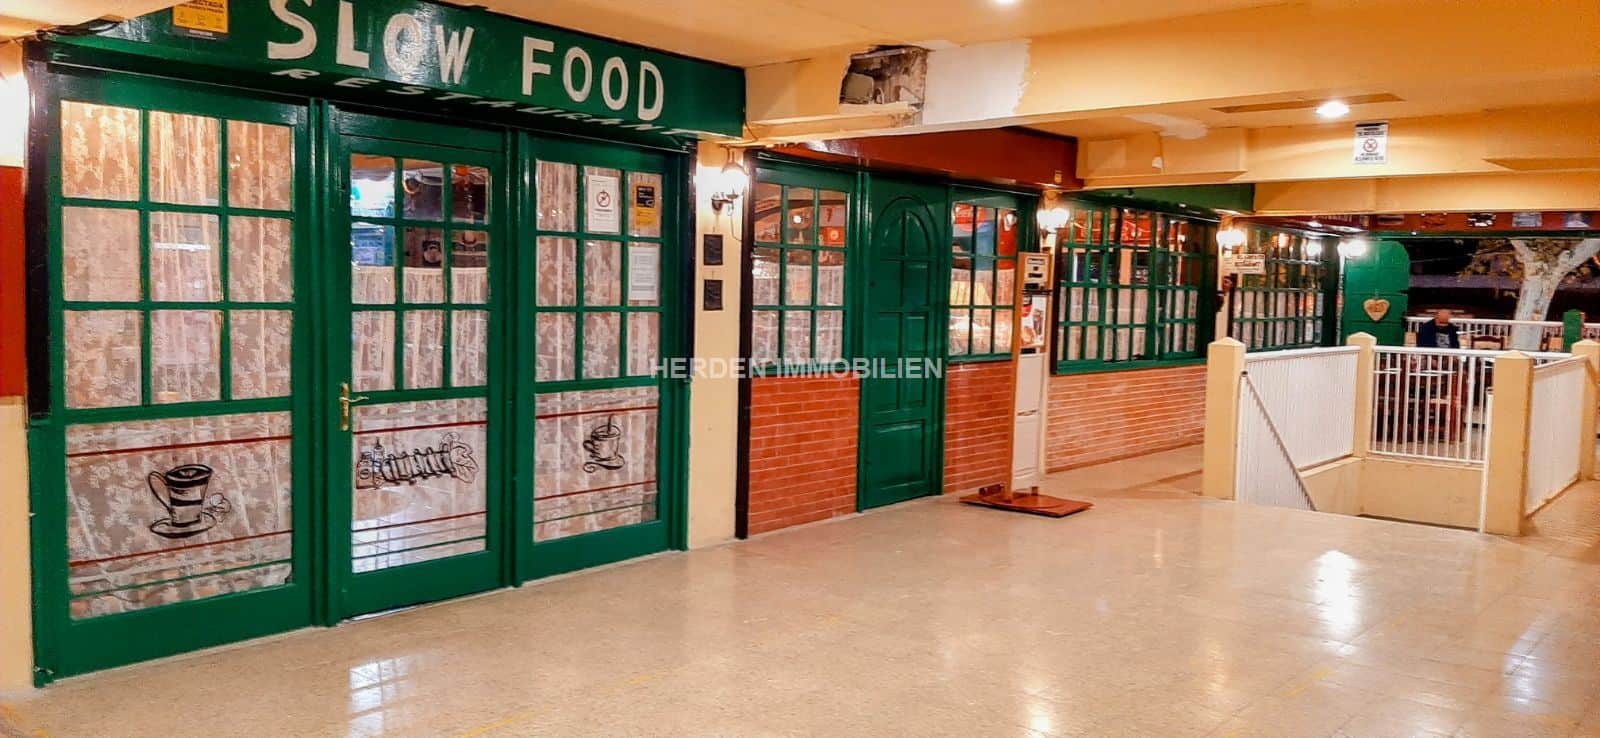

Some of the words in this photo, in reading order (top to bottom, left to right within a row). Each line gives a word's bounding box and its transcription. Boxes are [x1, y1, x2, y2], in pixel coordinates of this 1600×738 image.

[267, 0, 476, 86] SLOW
[521, 36, 665, 122] FOOD
[271, 68, 702, 139] RESTAURANT
